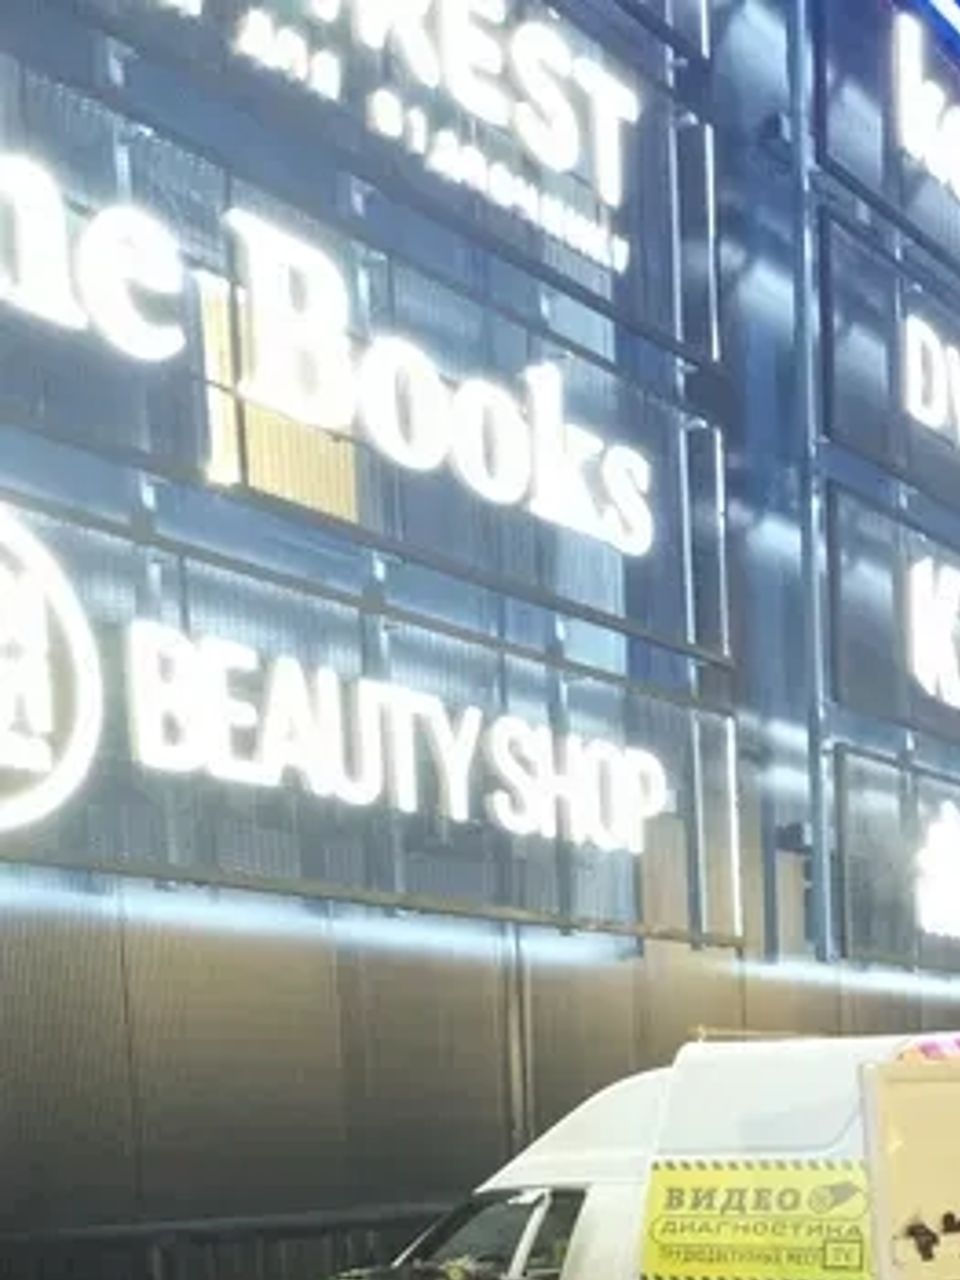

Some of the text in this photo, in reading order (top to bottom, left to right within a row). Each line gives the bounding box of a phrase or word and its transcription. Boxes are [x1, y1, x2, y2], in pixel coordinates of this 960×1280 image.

[222, 203, 655, 556] Books
[130, 617, 674, 854] BEAUTY SHOP
[660, 1219, 862, 1239] ДИАГНОСТИКА
[664, 1187, 802, 1216] ВИДЕО
